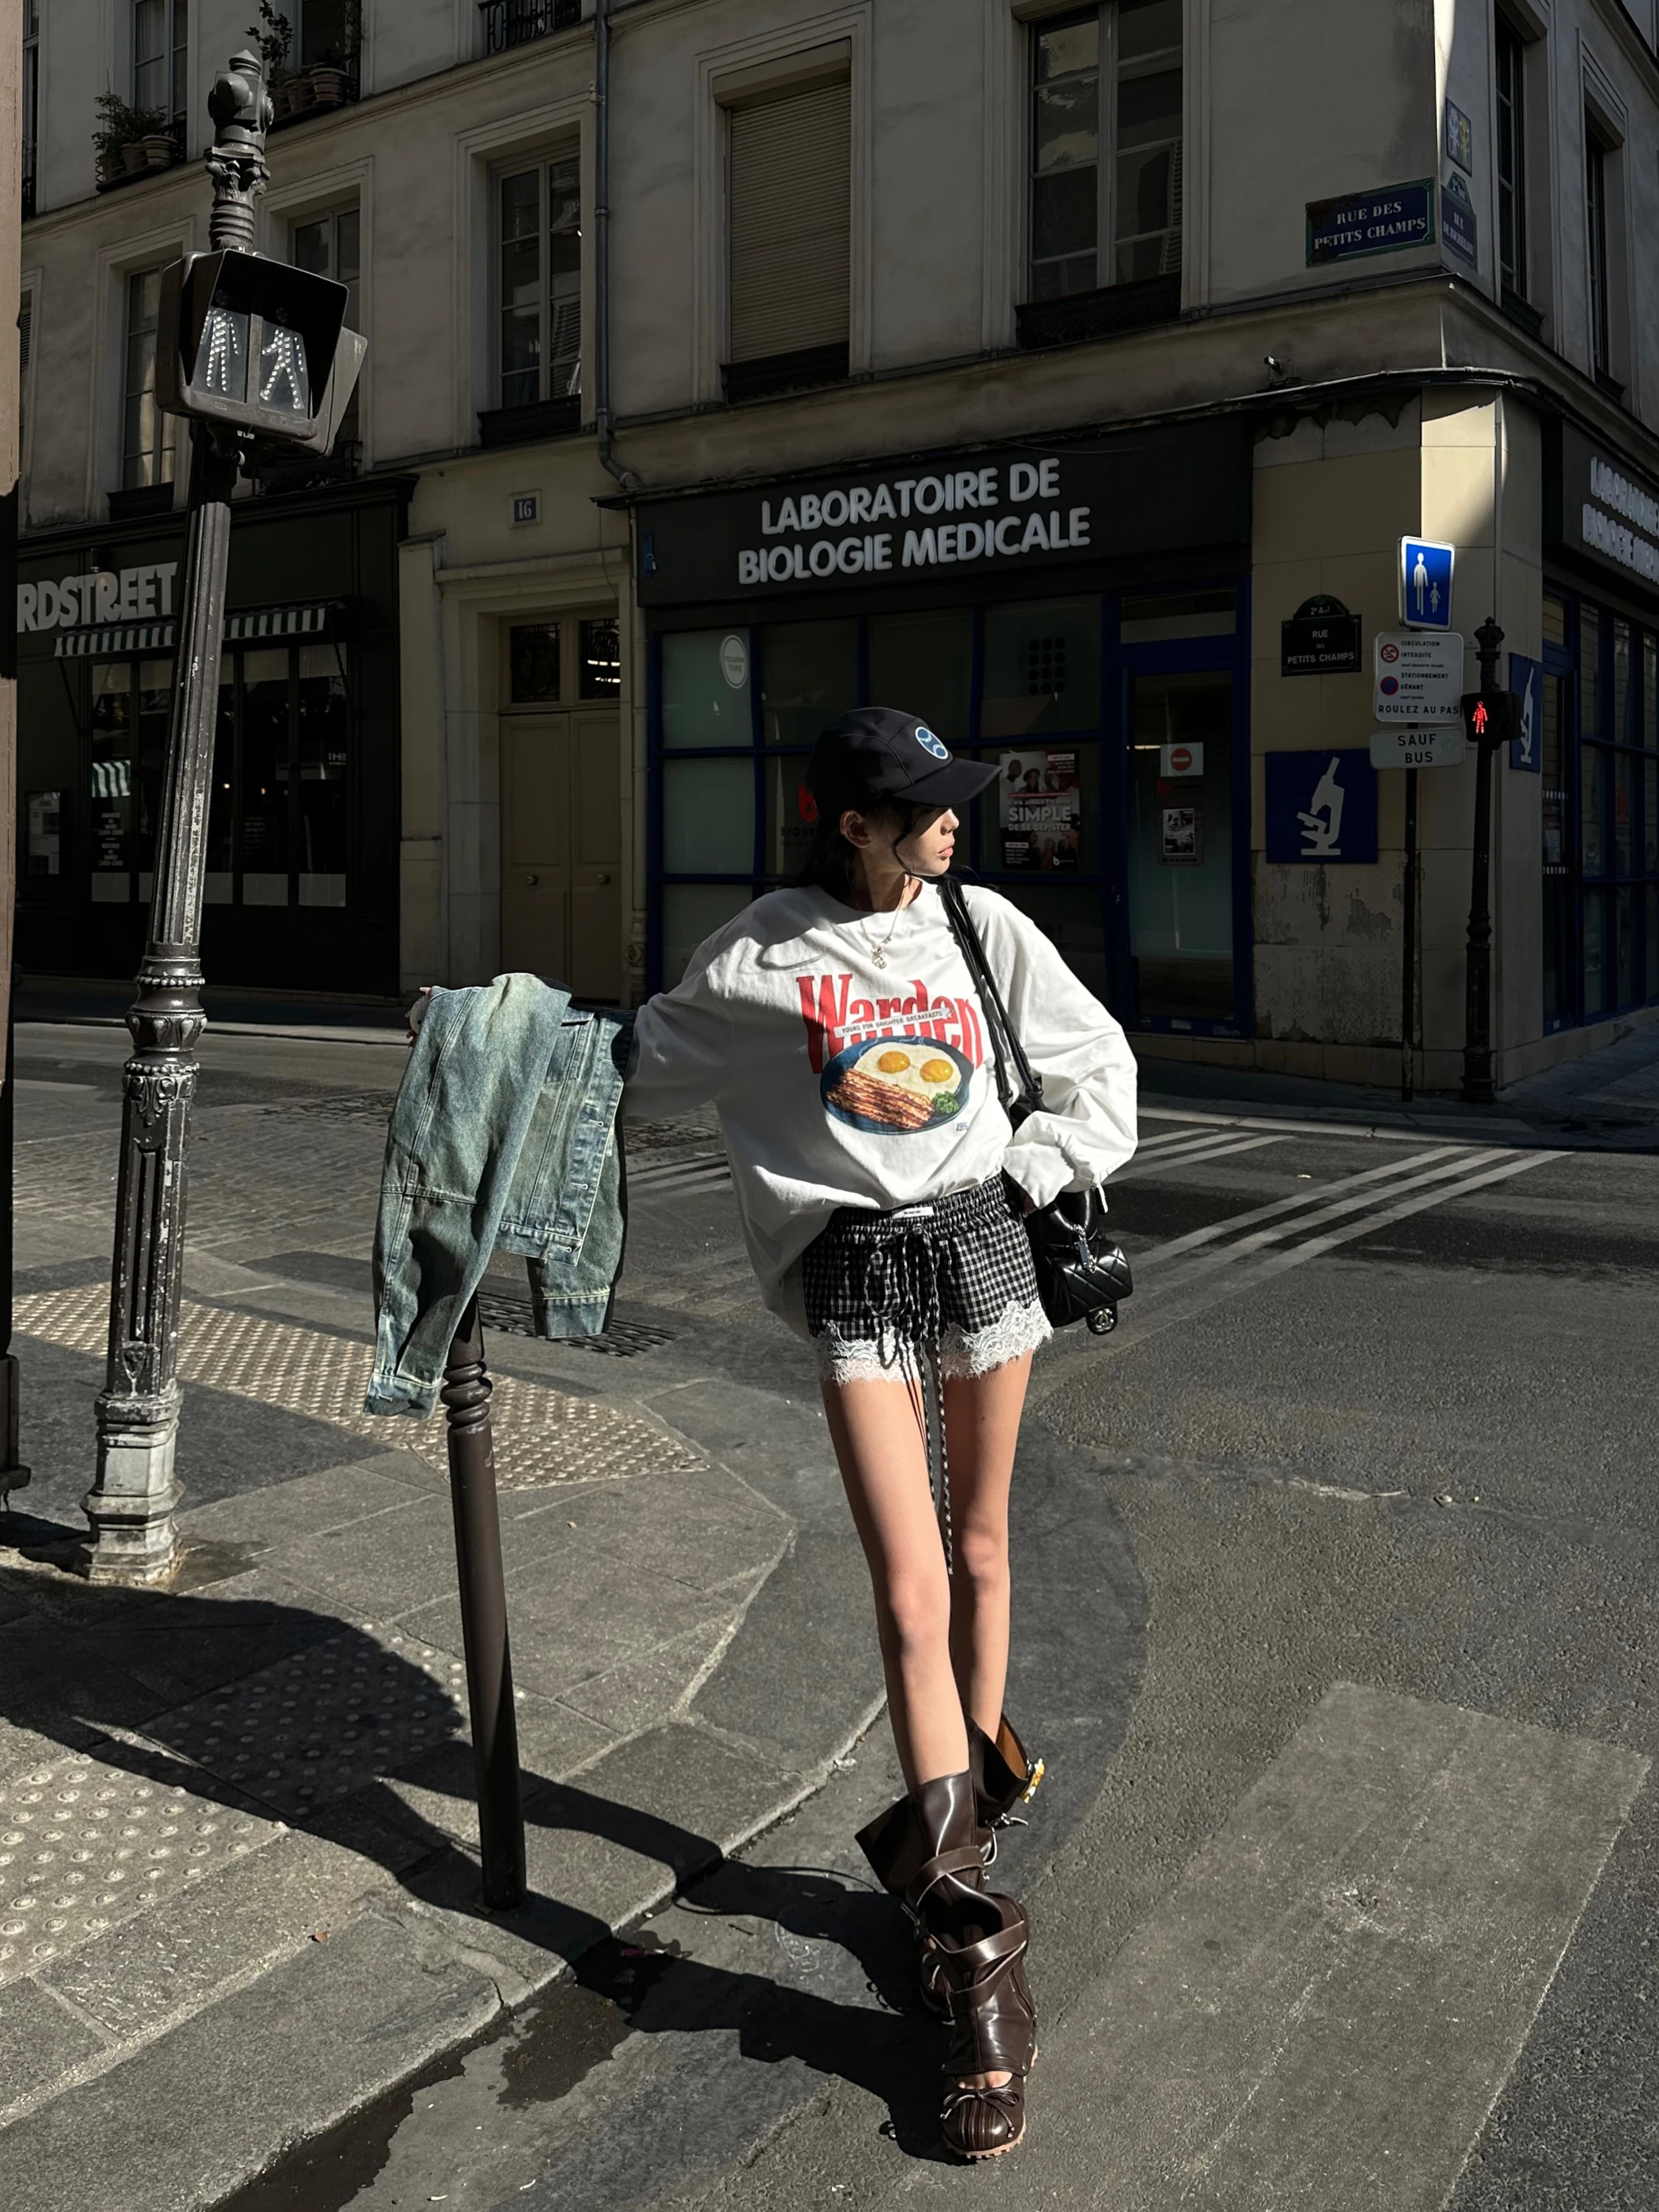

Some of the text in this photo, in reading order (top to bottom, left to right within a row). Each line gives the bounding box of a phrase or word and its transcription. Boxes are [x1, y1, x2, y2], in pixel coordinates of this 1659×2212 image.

[1336, 201, 1402, 225] RUE DES
[1314, 217, 1426, 250] PETITS CHAMPS
[762, 457, 1061, 535] LABORATOIRE DE
[518, 500, 532, 519] 16
[739, 506, 1091, 585] BIOLOGIE MEDICALE
[1312, 629, 1329, 639] RUE
[1287, 651, 1355, 664] PETITS CHAMPS
[1378, 704, 1459, 714] ROULEZ AU PAS
[1397, 733, 1436, 746] SAUF
[1405, 751, 1433, 764] BUS
[1008, 806, 1072, 823] SIMPLE
[796, 973, 984, 1074] Warden
[841, 1025, 860, 1034] YOURS
[875, 1018, 904, 1028] BRIGHTER
[906, 1012, 943, 1023] BREAKFASTS
